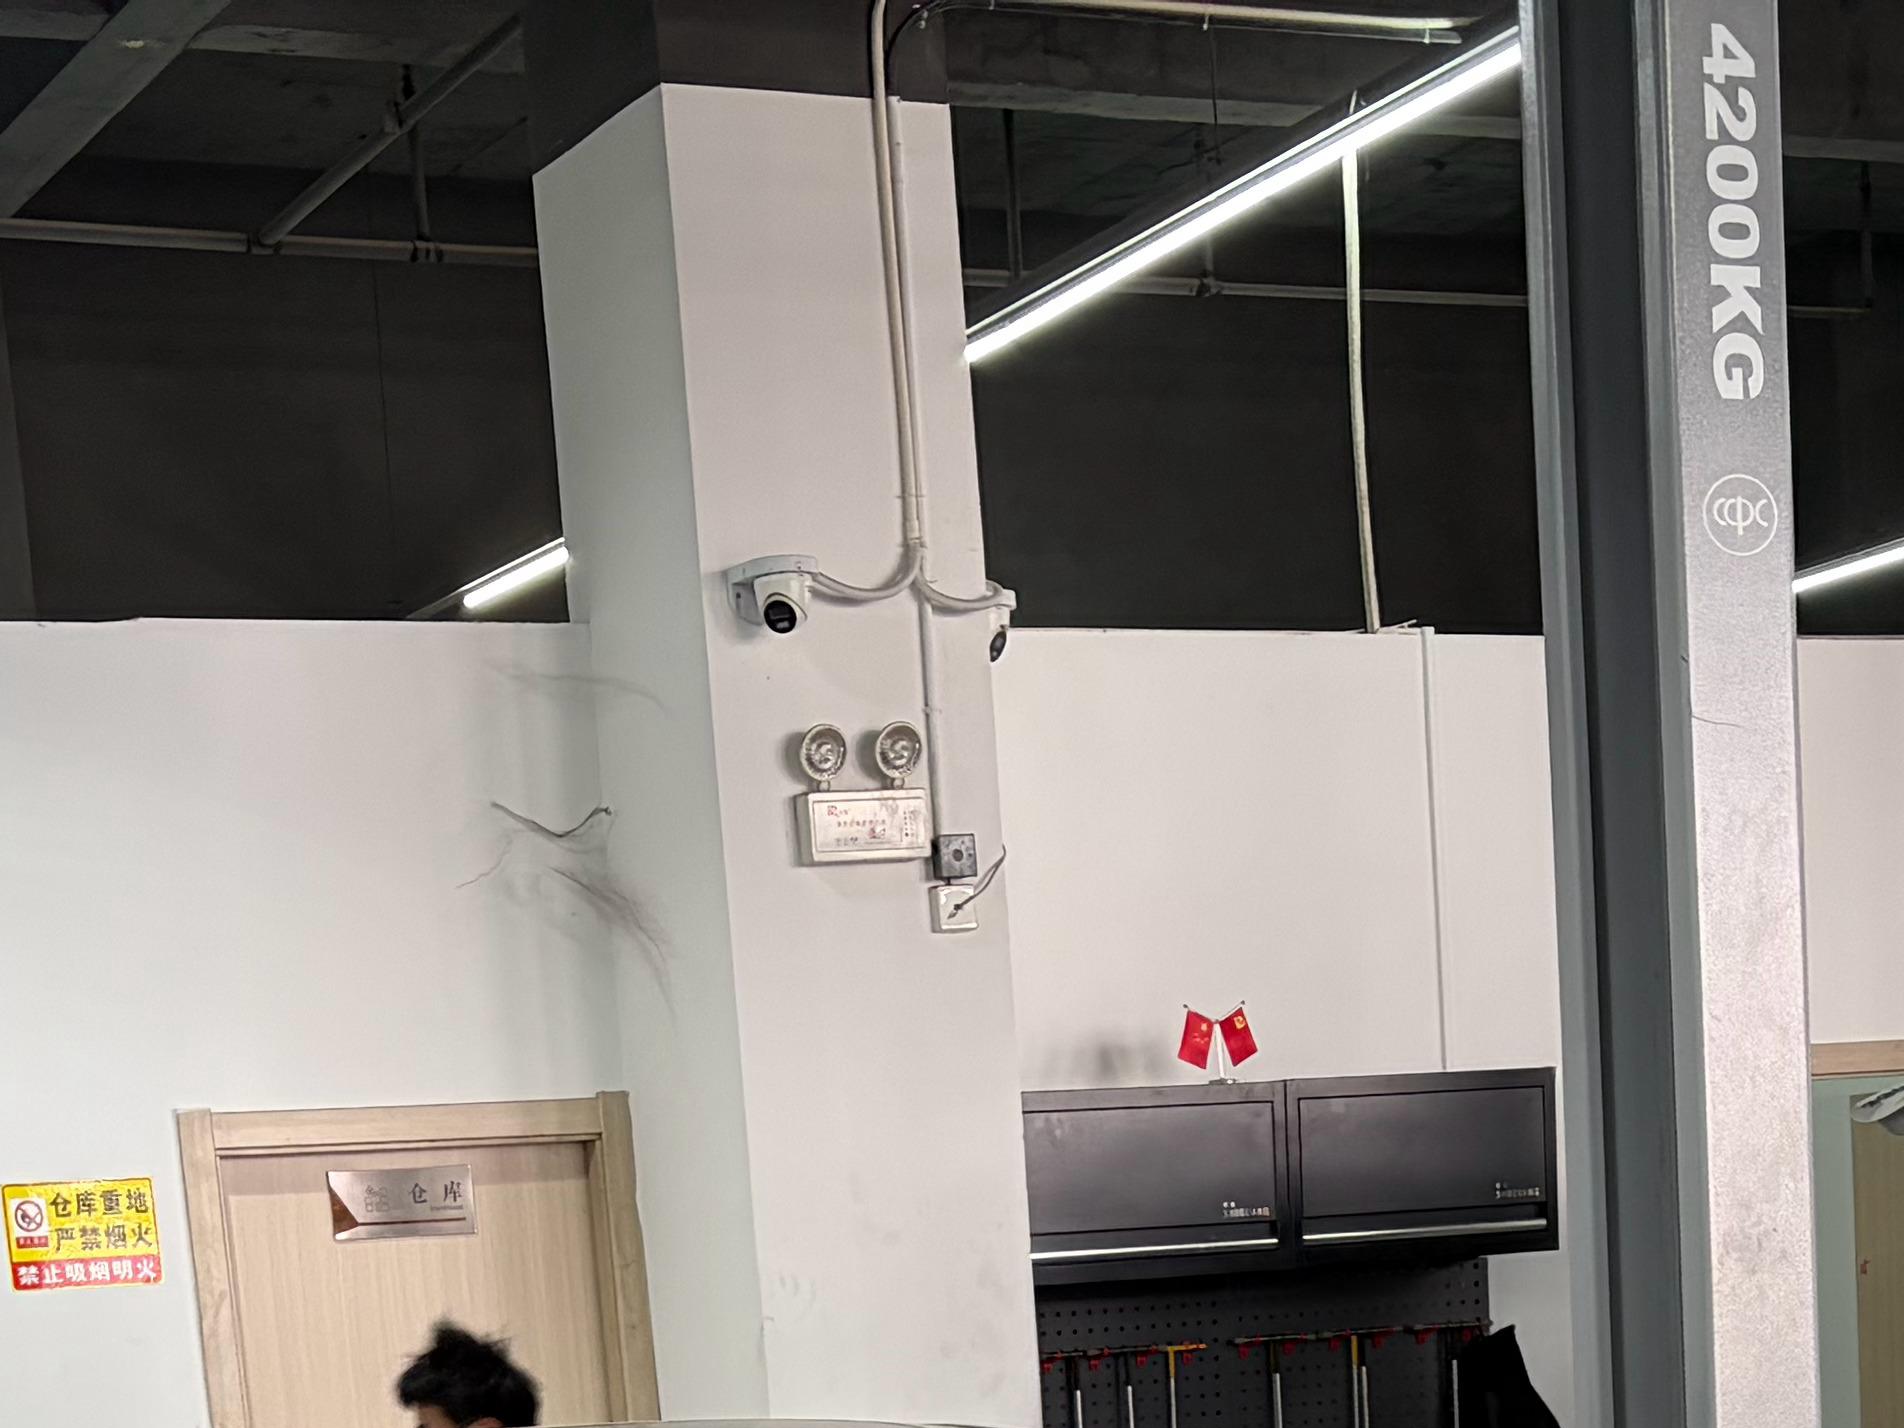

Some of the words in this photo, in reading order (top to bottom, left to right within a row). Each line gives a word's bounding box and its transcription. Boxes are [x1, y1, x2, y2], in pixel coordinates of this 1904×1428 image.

[1702, 23, 1765, 400] 4200KG
[50, 1188, 149, 1218] 仓库重地
[409, 1181, 463, 1204] 仓库
[55, 1223, 153, 1252] 严禁烟火
[18, 1260, 156, 1285] 禁止吸烟明火
